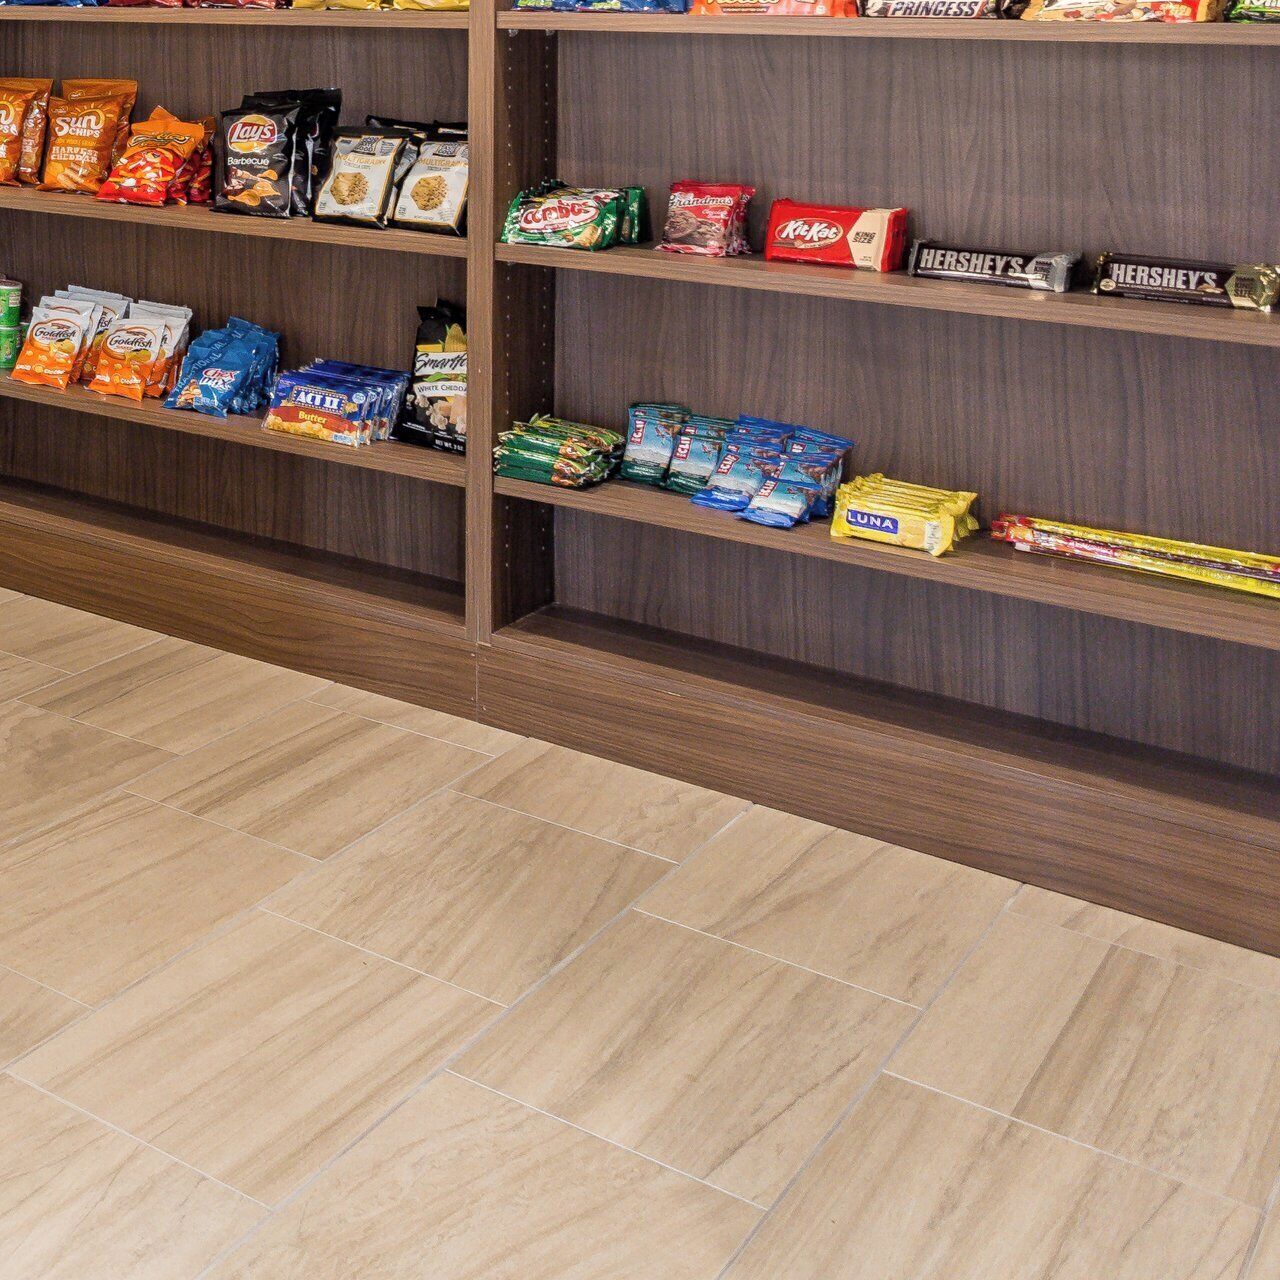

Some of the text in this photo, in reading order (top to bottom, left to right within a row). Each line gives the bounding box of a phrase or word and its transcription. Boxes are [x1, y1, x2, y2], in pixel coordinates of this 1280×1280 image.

[54, 114, 97, 136] Sun
[69, 127, 100, 139] CHIPS
[231, 122, 274, 144] Lay's
[50, 146, 99, 156] HARVEST
[50, 153, 98, 164] CHEDDAR
[227, 156, 270, 166] Barbecue
[669, 193, 734, 208] Grandma's
[853, 236, 873, 244] SIZE
[854, 230, 877, 239] KING
[920, 248, 1024, 276] HERSHEY'S
[1111, 263, 1217, 290] HERSHEY'S
[34, 326, 76, 339] Goldfish
[108, 335, 153, 349] Goldfish
[417, 384, 439, 393] WHITE
[295, 390, 341, 409] ACT II
[298, 410, 328, 424] Butter
[848, 510, 895, 530] LUNA
